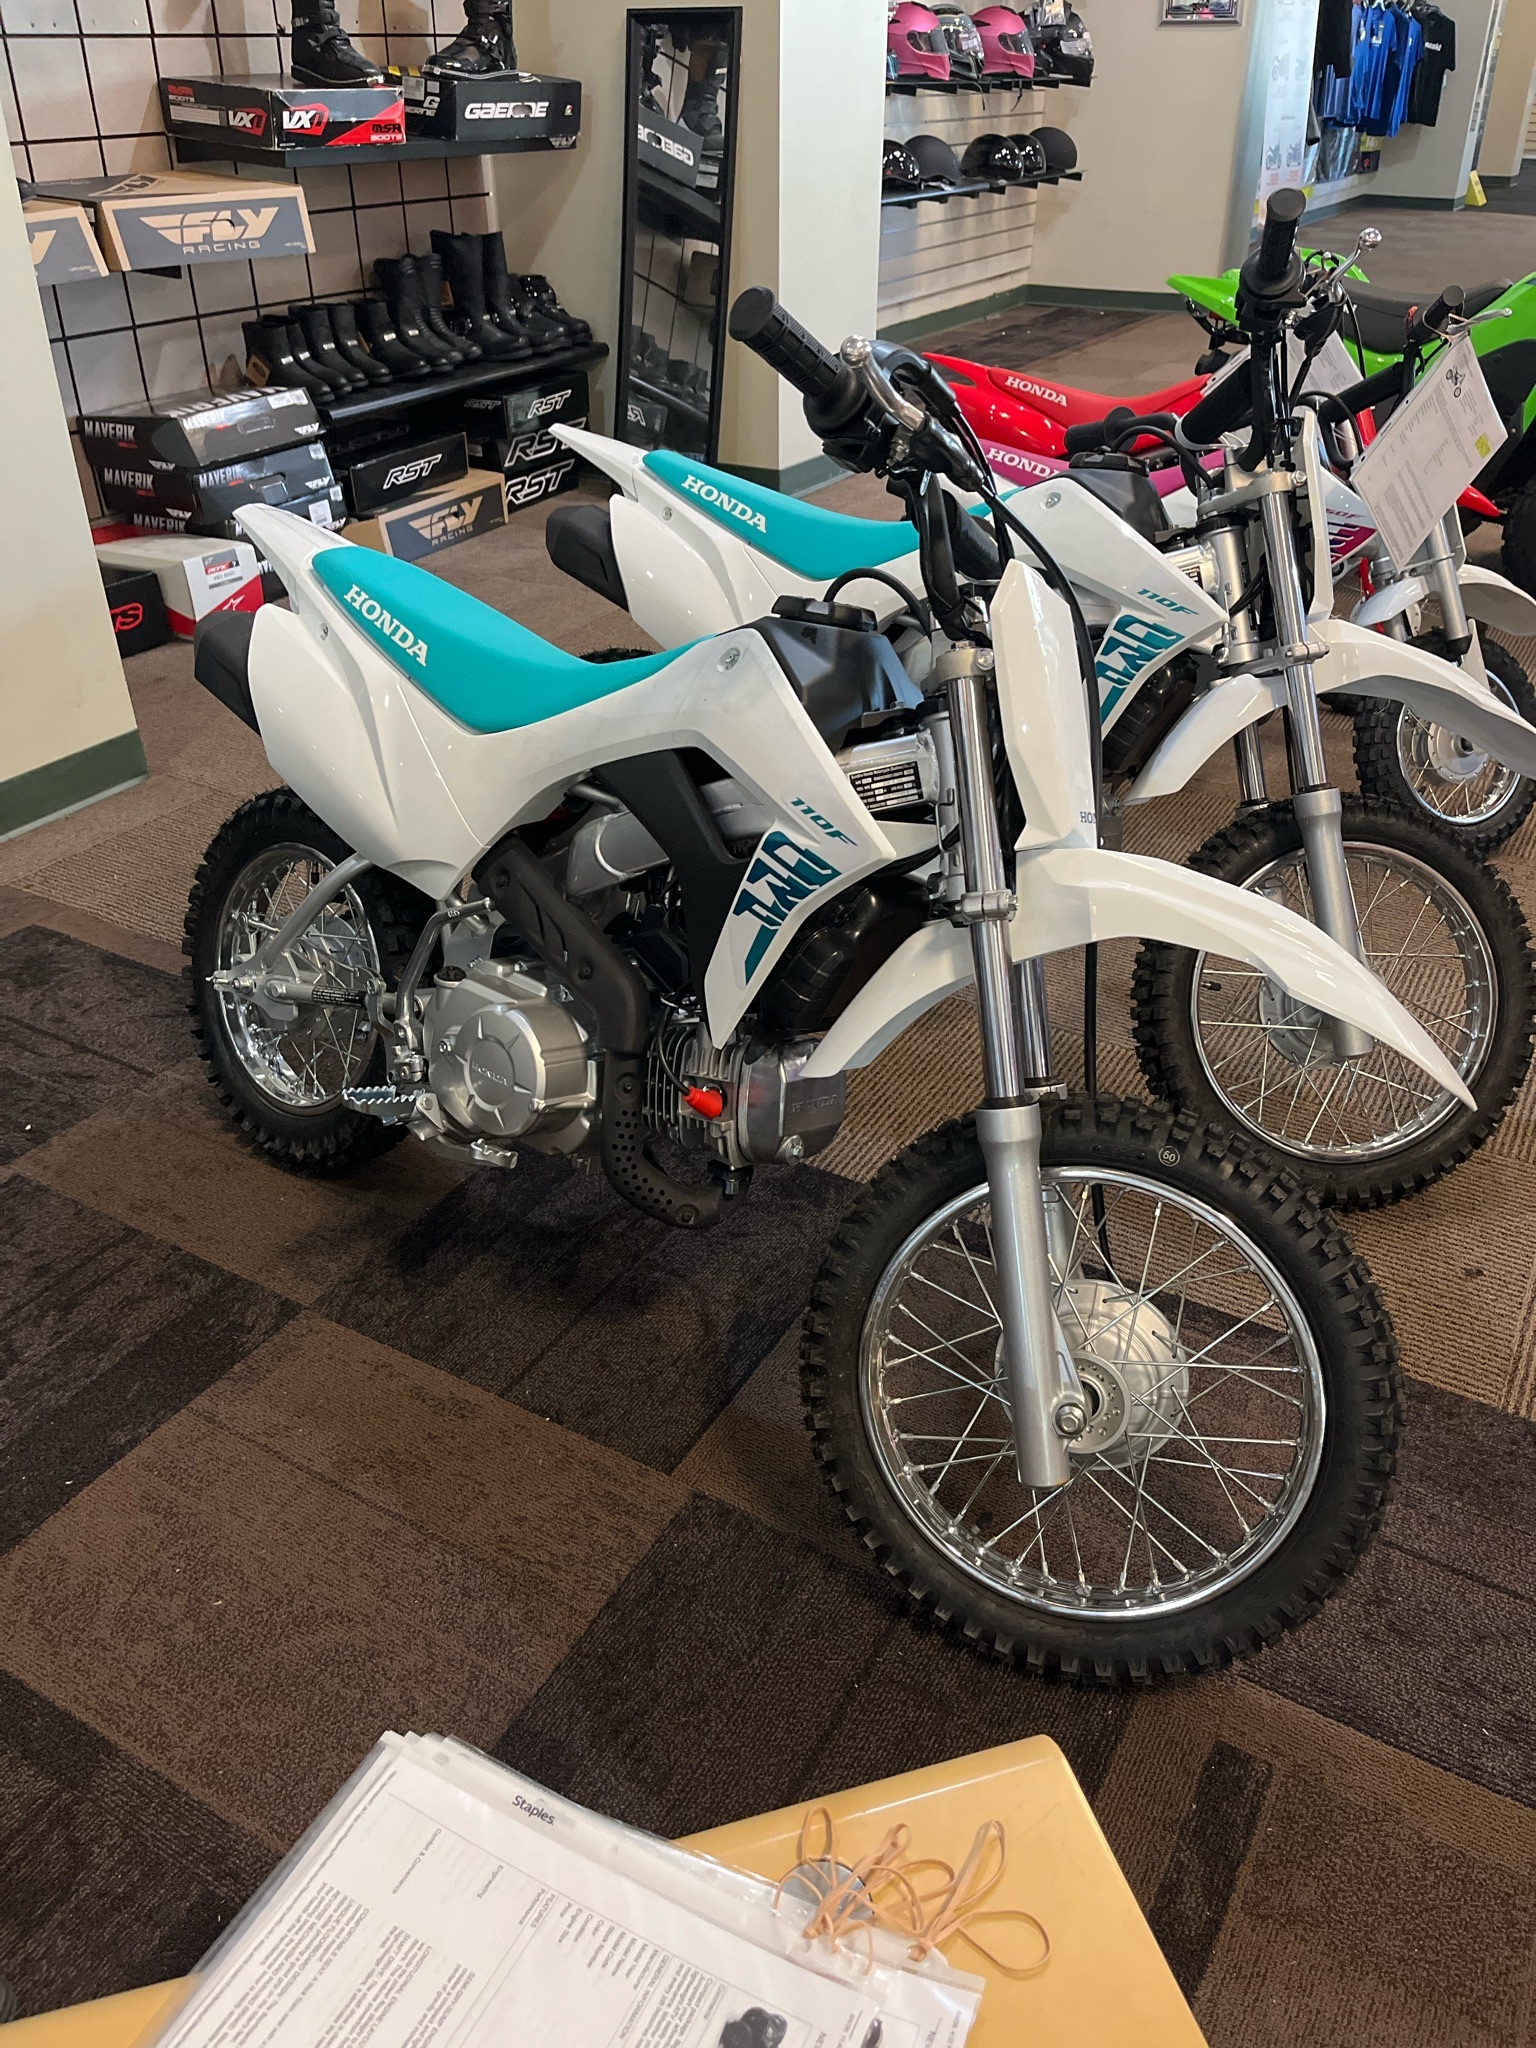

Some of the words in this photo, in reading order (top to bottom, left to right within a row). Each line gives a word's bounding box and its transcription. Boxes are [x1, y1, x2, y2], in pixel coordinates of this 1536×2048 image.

[370, 134, 403, 142] BOOTS
[140, 207, 279, 246] FLY
[182, 240, 261, 255] RACING
[528, 389, 572, 419] RST
[1004, 375, 1068, 407] HONDA
[84, 419, 135, 442] MAVERIK
[294, 422, 320, 435] FLY
[148, 459, 175, 472] FLY
[199, 466, 243, 489] MAVERIK
[383, 454, 442, 490] RST
[104, 467, 154, 491] MAVERIK
[305, 476, 331, 490] FLY
[506, 459, 575, 506] RST
[681, 474, 767, 533] HONDA
[134, 513, 186, 534] MAVERIK
[431, 525, 474, 547] RACING
[1137, 588, 1199, 615] 110F
[343, 584, 429, 667] HONDA
[790, 797, 858, 846] 110F
[421, 1826, 442, 1852] Comfort
[418, 1849, 425, 1857] &
[390, 1855, 421, 1895] Convenience
[475, 1863, 505, 1900] Engineering
[516, 1886, 546, 1926] Performance
[528, 1892, 556, 1929] FEATURES
[558, 1900, 572, 1918] Price
[565, 1906, 584, 1930] Engine
[556, 1928, 570, 1944] Size
[571, 1912, 594, 1943] Condition
[589, 1918, 605, 1937] Color
[645, 1954, 670, 1989] GENERAL
[617, 1987, 650, 2040] INFORMATION
